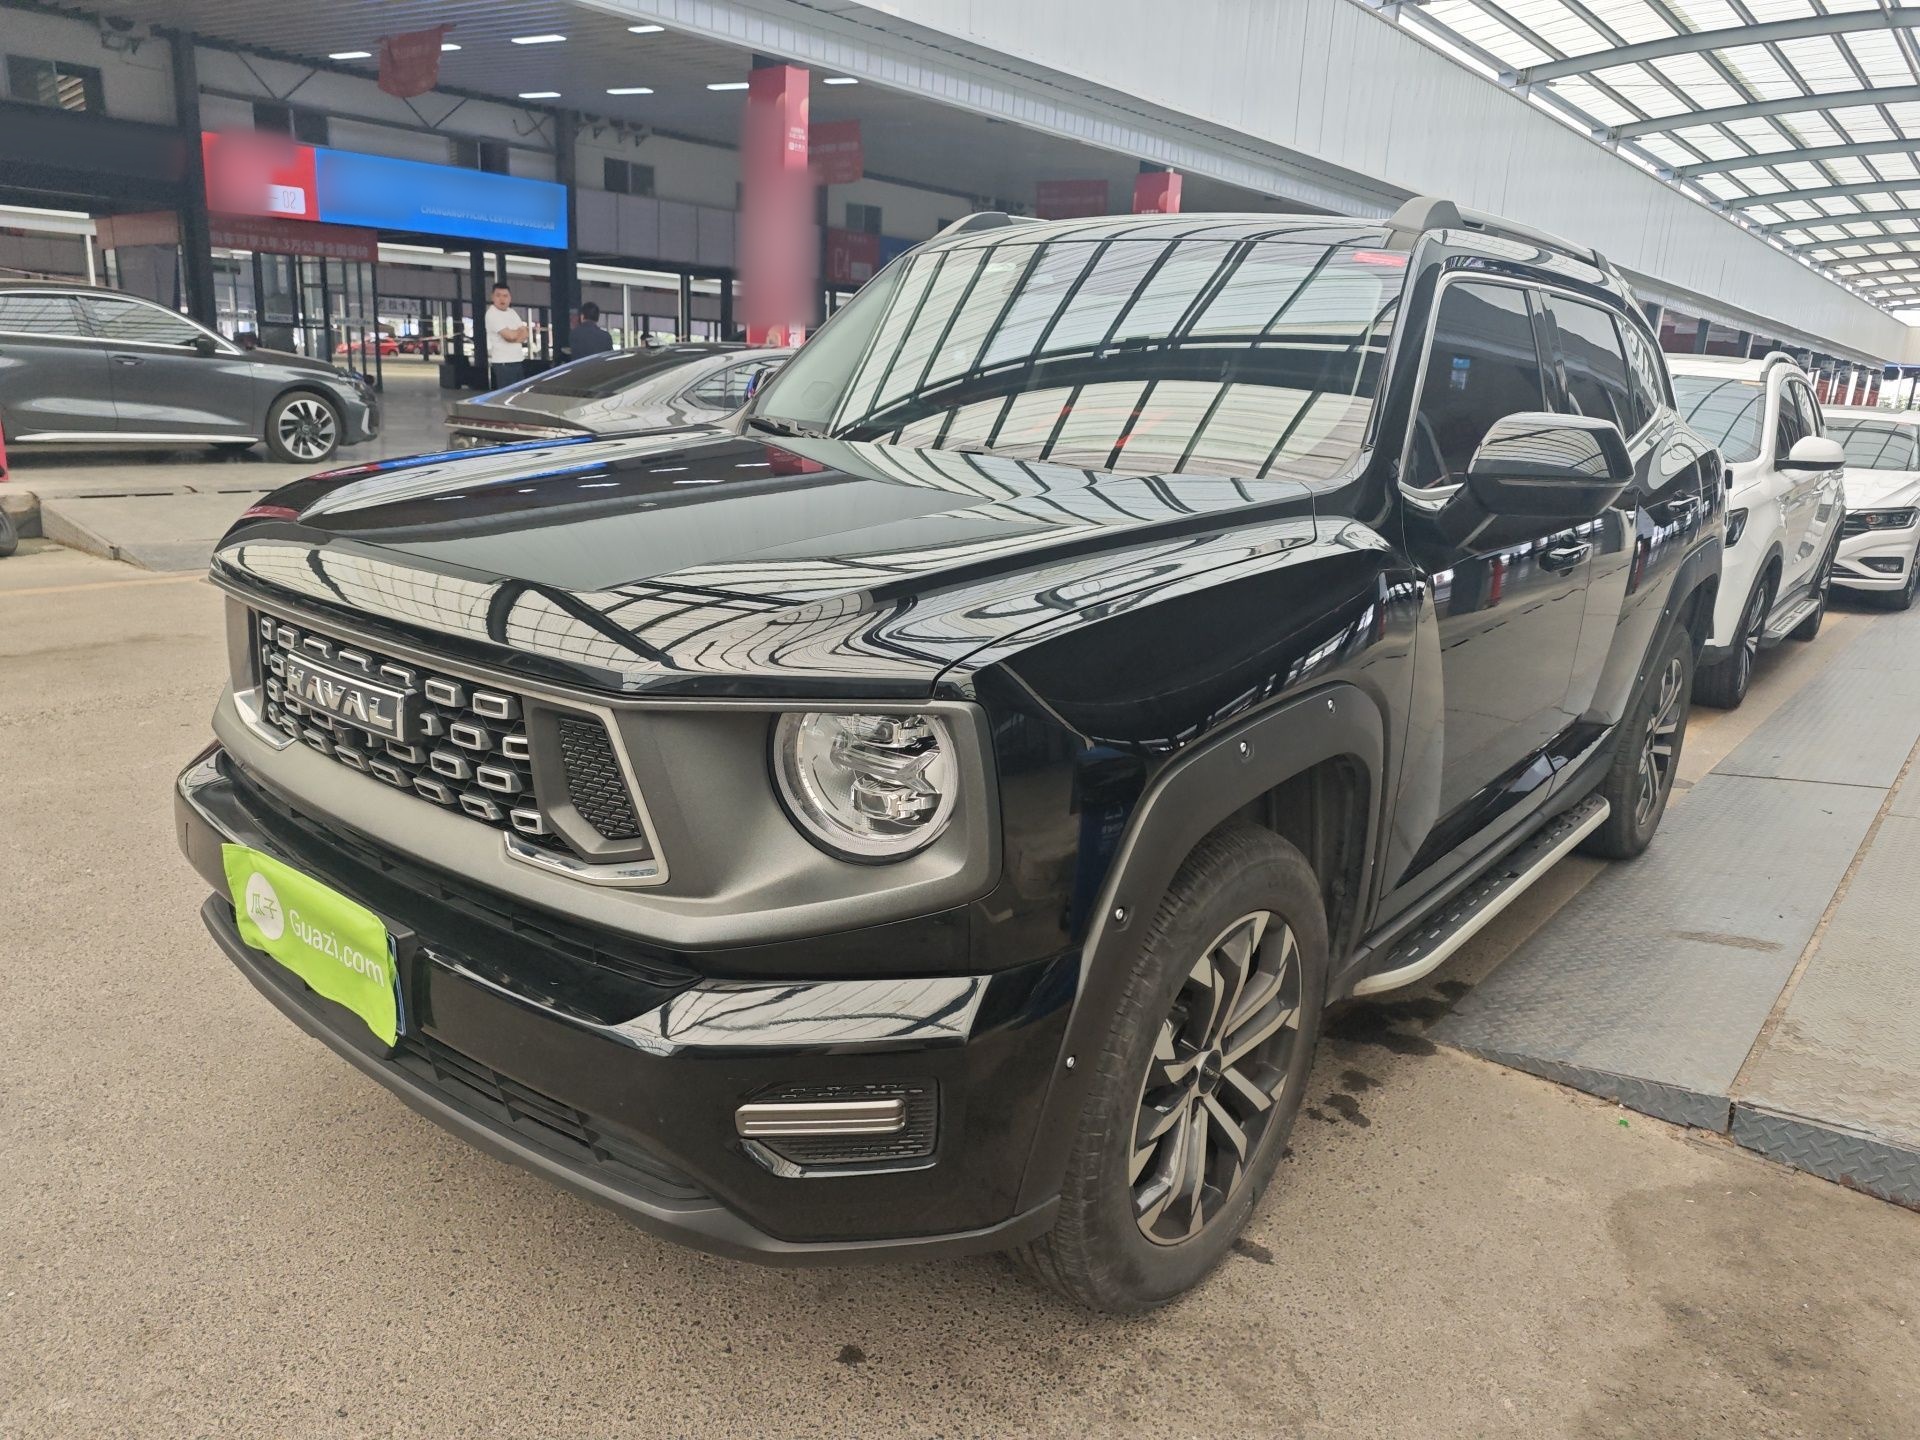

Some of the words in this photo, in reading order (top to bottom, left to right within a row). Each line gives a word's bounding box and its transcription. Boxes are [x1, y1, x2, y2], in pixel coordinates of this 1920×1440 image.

[287, 664, 393, 730] HAVAL
[250, 892, 279, 920] 瓜子
[288, 909, 386, 988] Guazi.com
